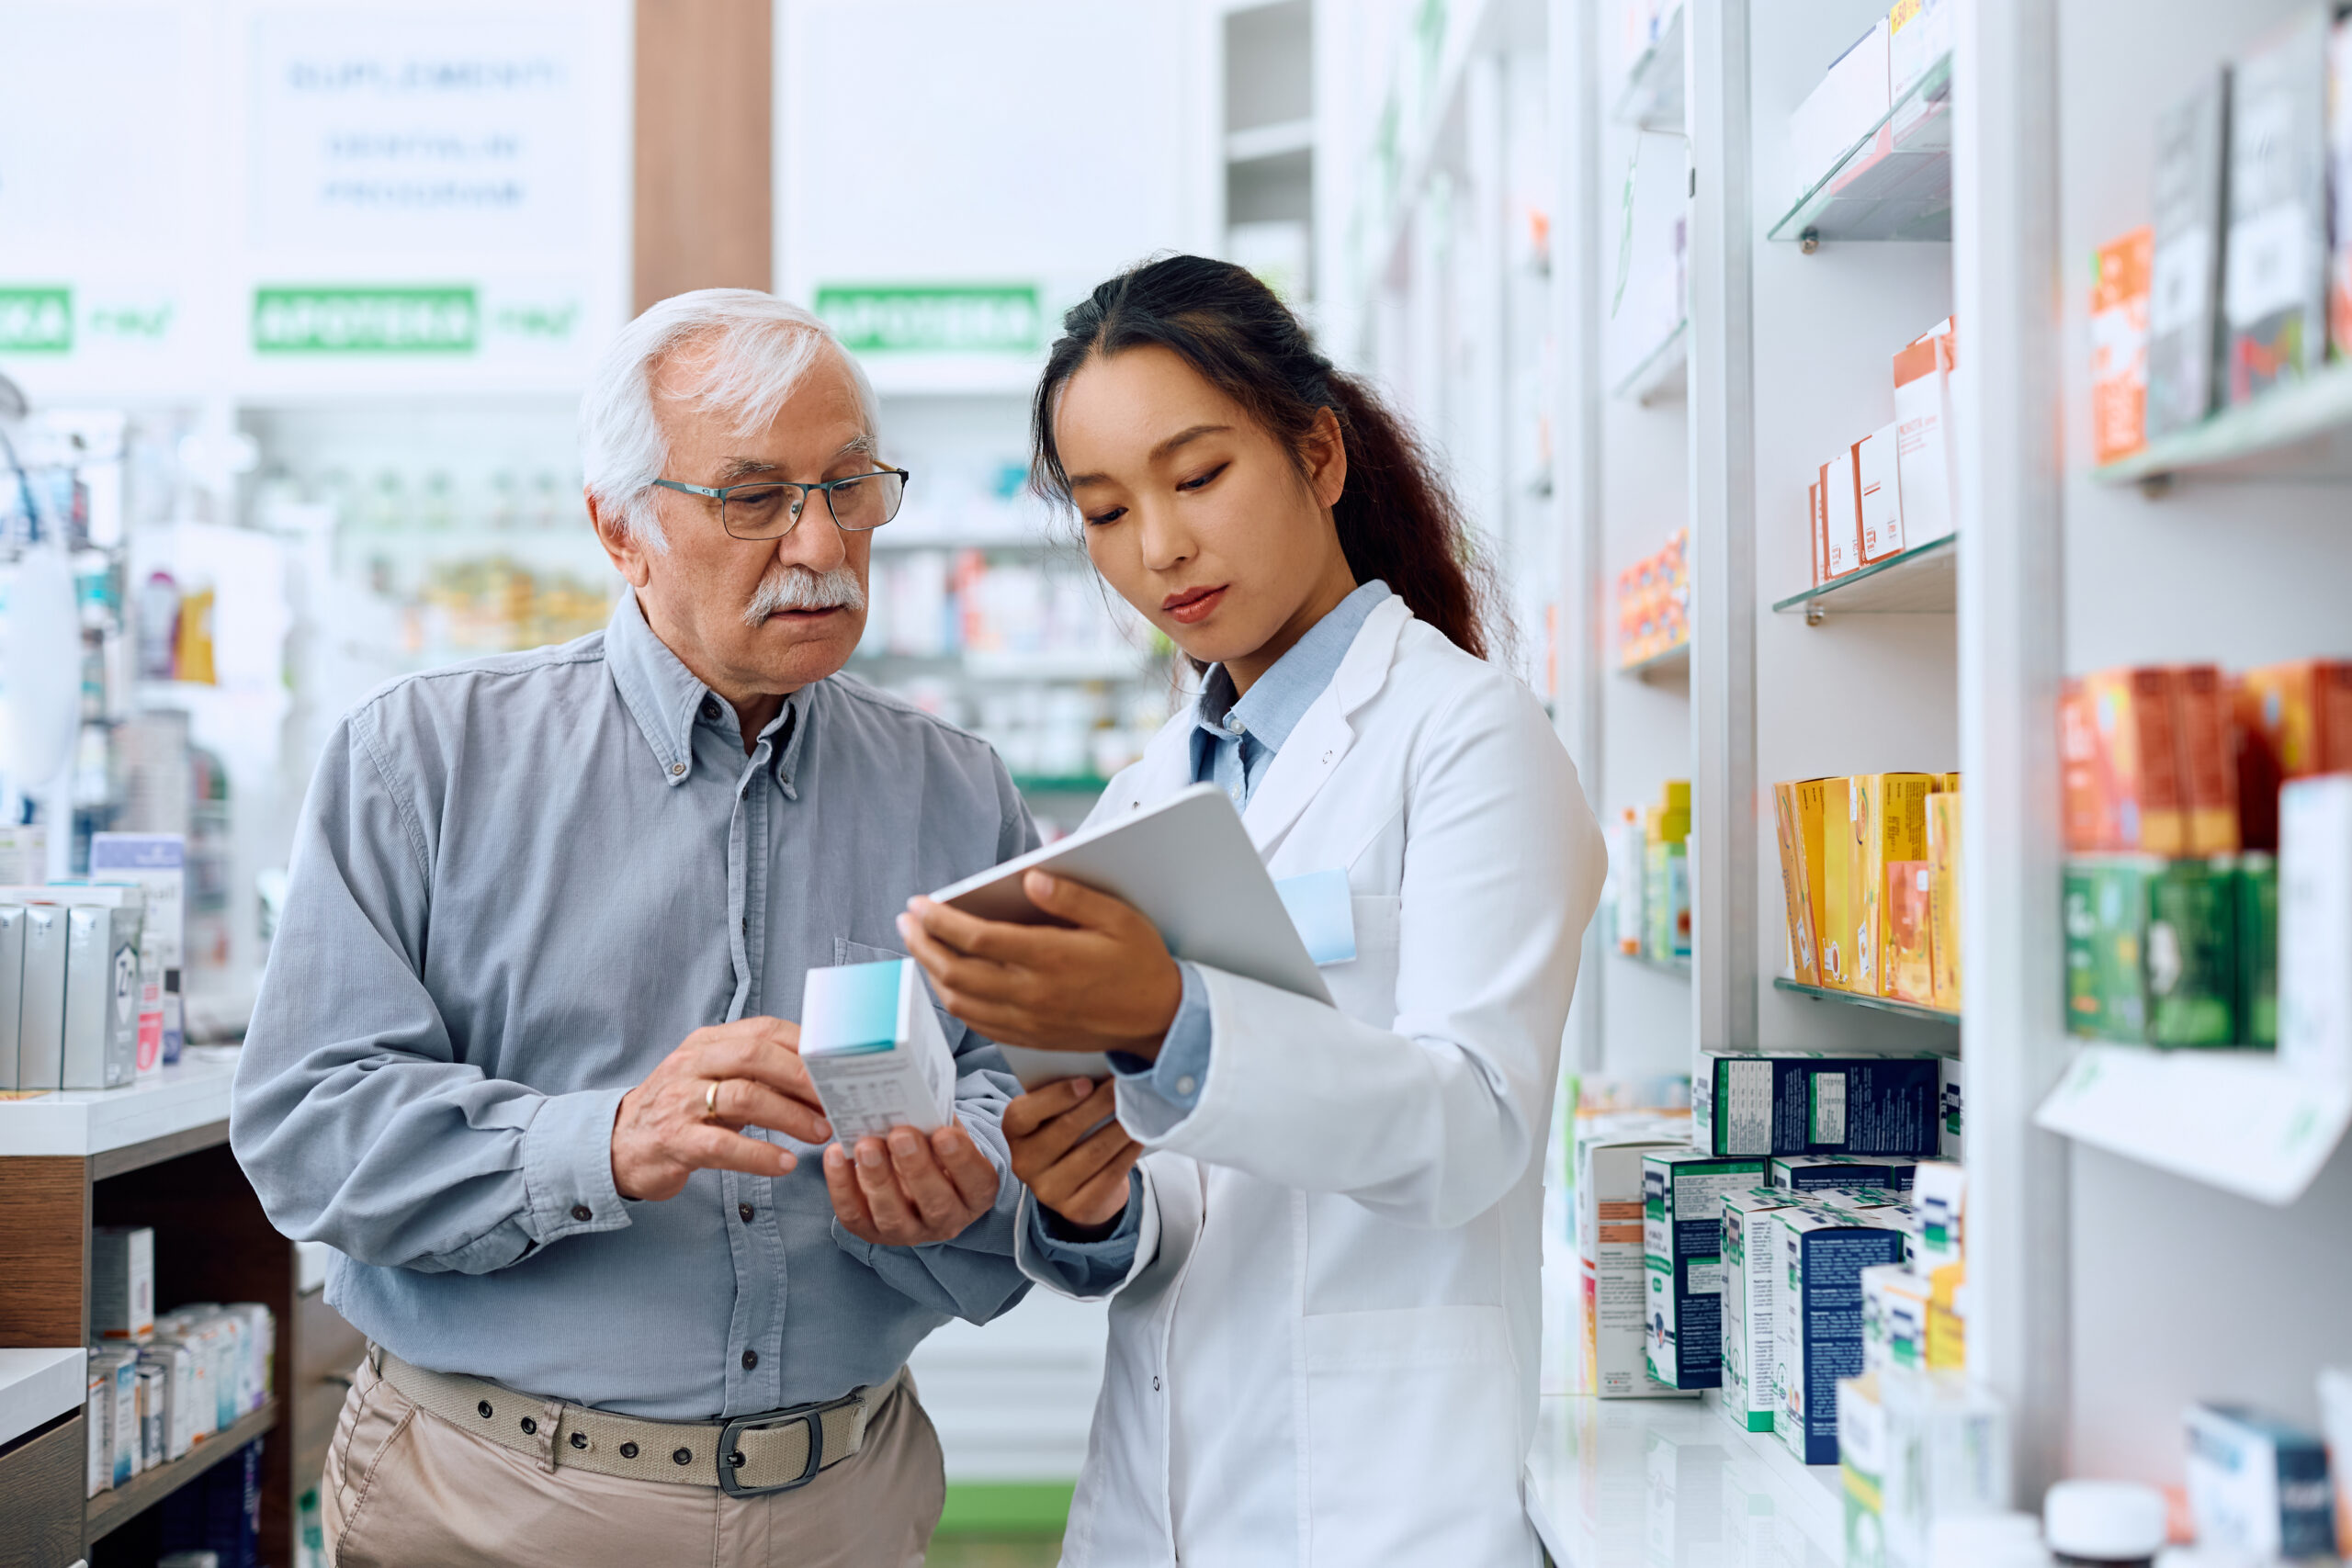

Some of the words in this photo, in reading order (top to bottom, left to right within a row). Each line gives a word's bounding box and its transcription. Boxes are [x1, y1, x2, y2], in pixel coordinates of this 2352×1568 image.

[323, 178, 525, 207] PROGRAM
[259, 295, 471, 345] APOTEKA
[820, 294, 1033, 347] APOTEKA
